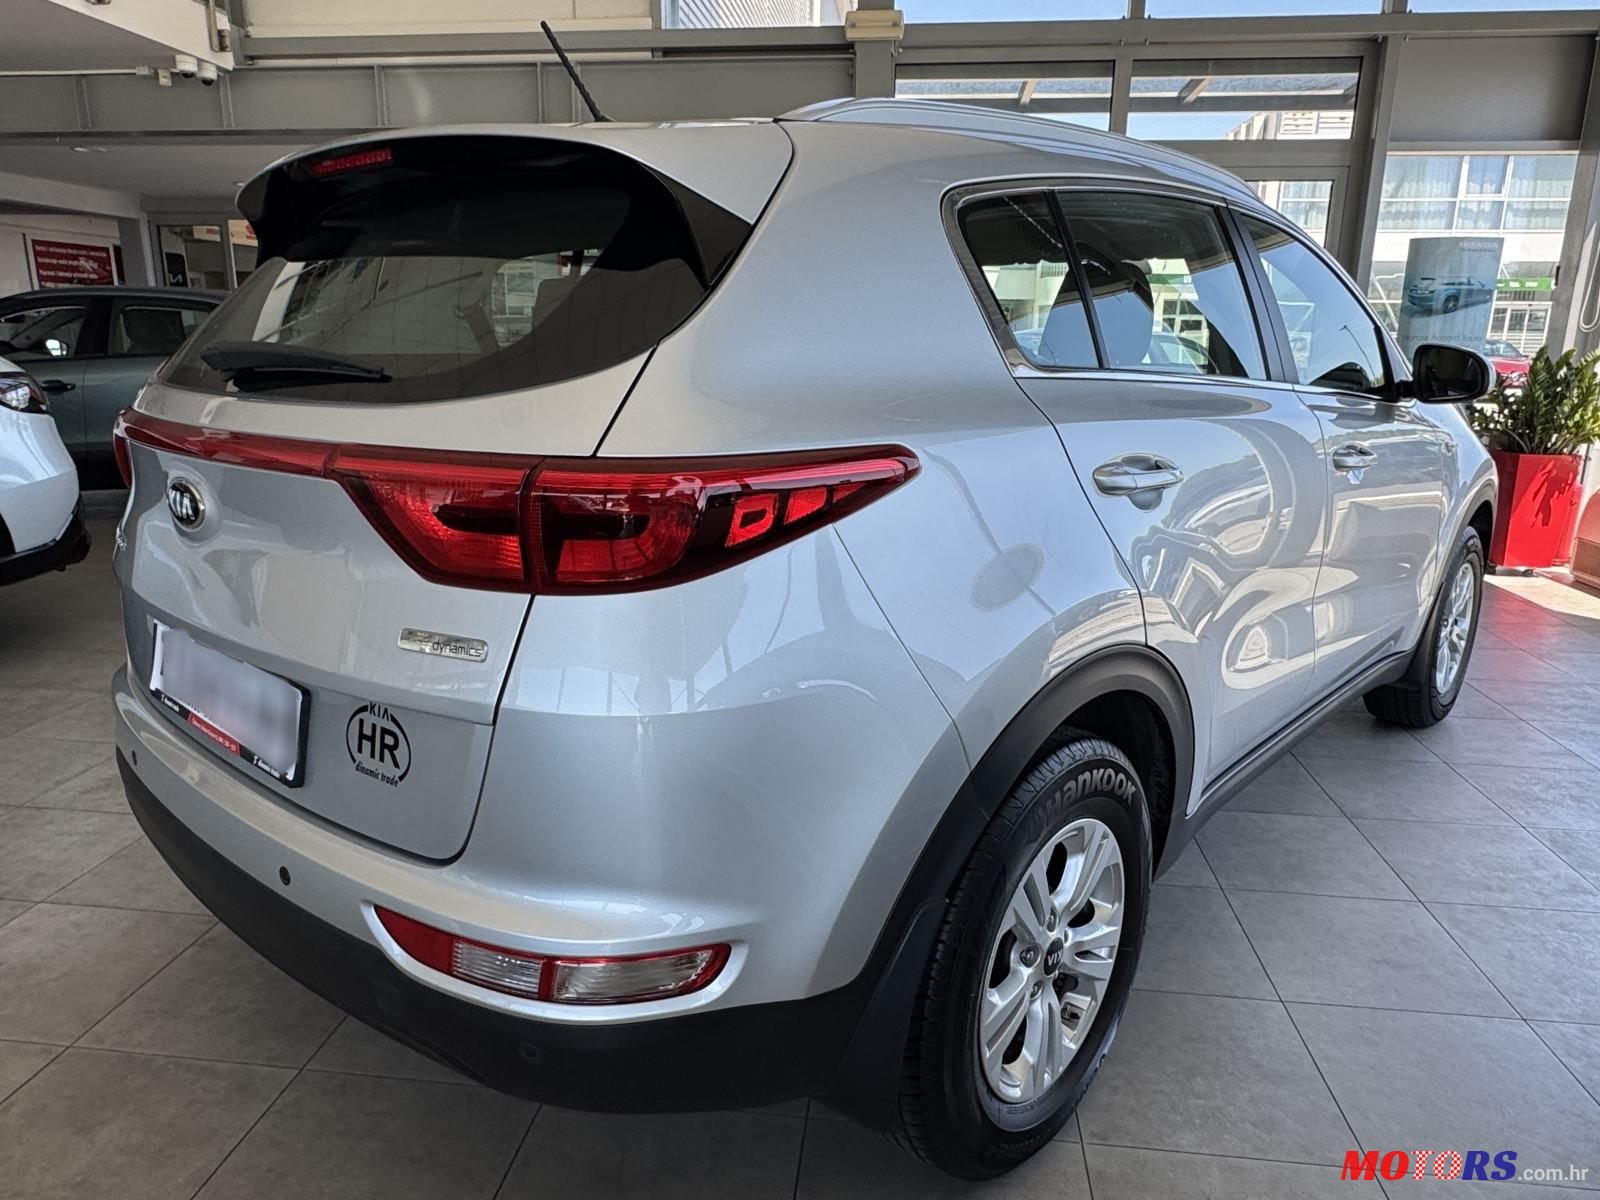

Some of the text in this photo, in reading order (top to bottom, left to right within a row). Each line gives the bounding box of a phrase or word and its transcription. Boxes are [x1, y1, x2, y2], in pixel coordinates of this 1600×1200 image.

[168, 489, 196, 520] KIA
[432, 639, 483, 657] dynamics
[369, 701, 389, 722] KIA
[357, 717, 400, 770] HR
